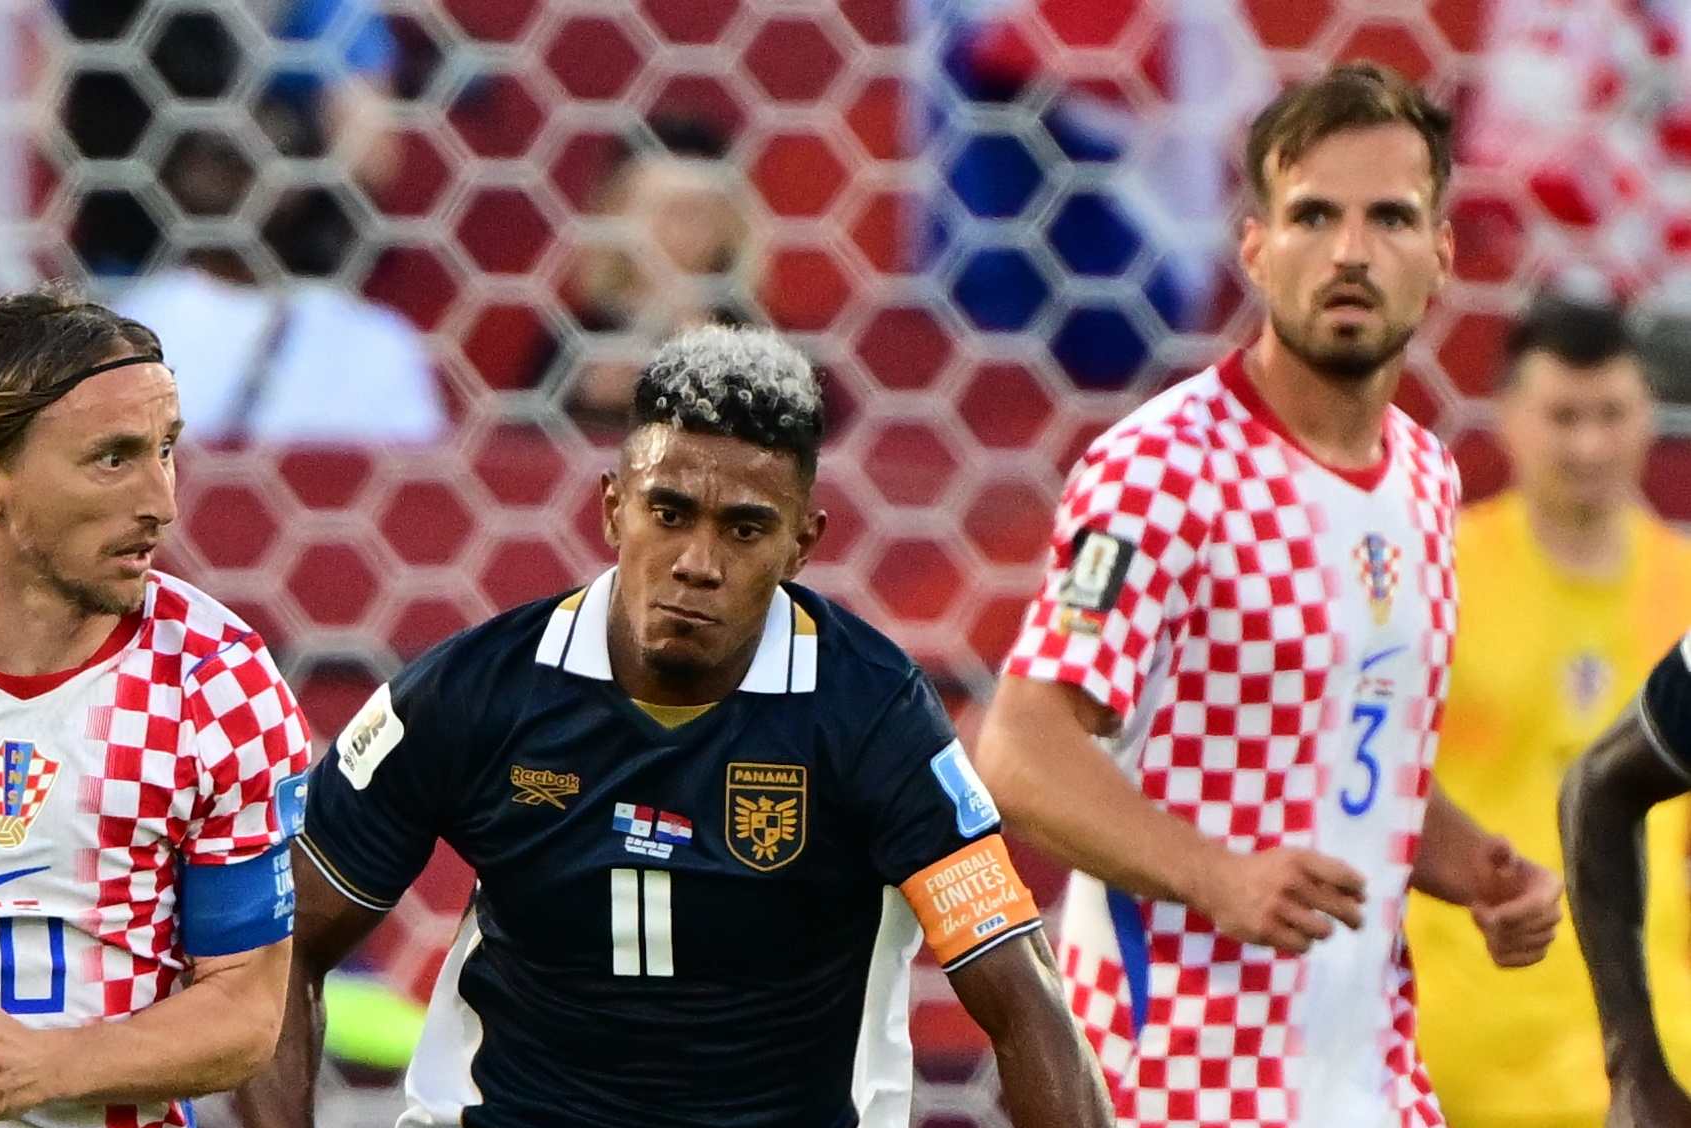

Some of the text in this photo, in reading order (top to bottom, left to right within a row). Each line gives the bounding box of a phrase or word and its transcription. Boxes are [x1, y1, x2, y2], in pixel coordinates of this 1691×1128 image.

[510, 765, 581, 793] Reebok
[1340, 703, 1386, 815] 3
[925, 848, 998, 894] FOOTBALL
[932, 863, 1006, 913] UNITES
[611, 868, 674, 976] 11
[941, 884, 1019, 936] the World
[976, 915, 1005, 934] FIFA
